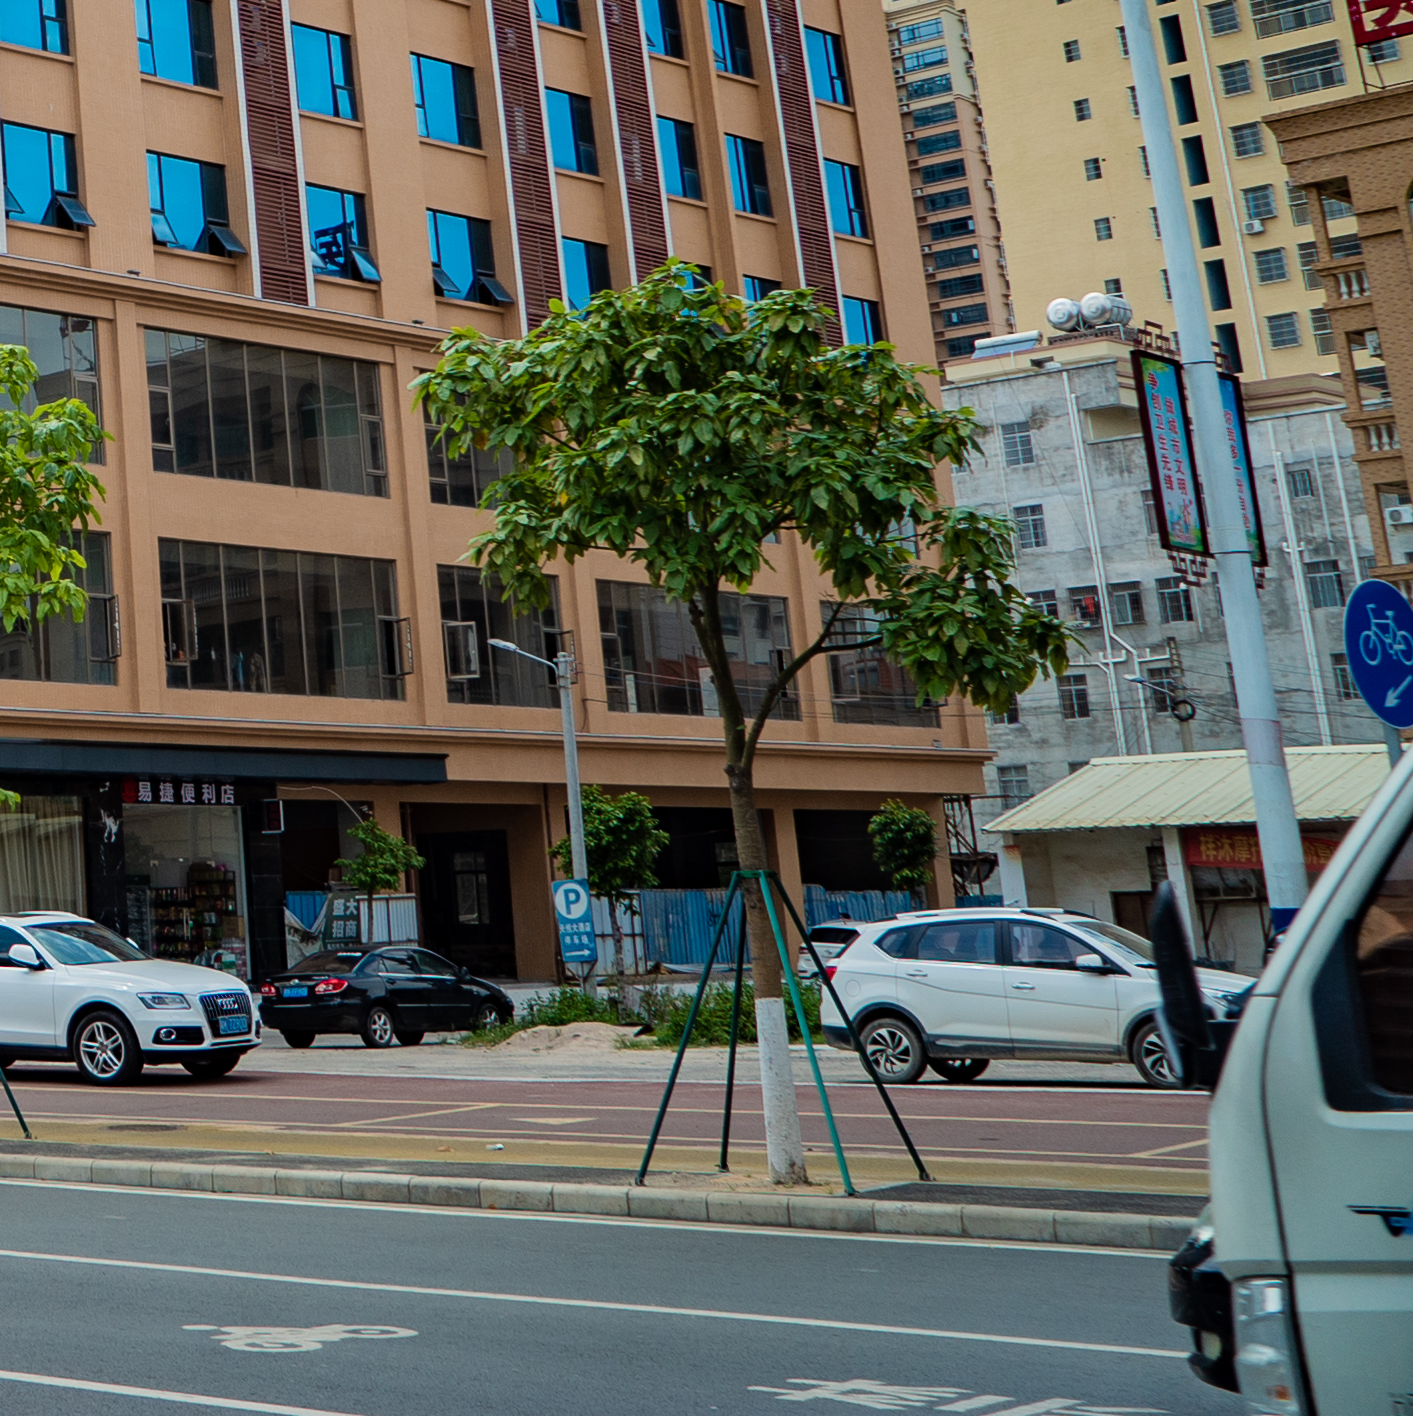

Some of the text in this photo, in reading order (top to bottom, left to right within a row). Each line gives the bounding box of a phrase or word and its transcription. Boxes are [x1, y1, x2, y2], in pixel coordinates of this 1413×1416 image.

[138, 781, 235, 804] 易捷便利店
[333, 898, 358, 916] 盛大
[332, 920, 357, 938] 招商
